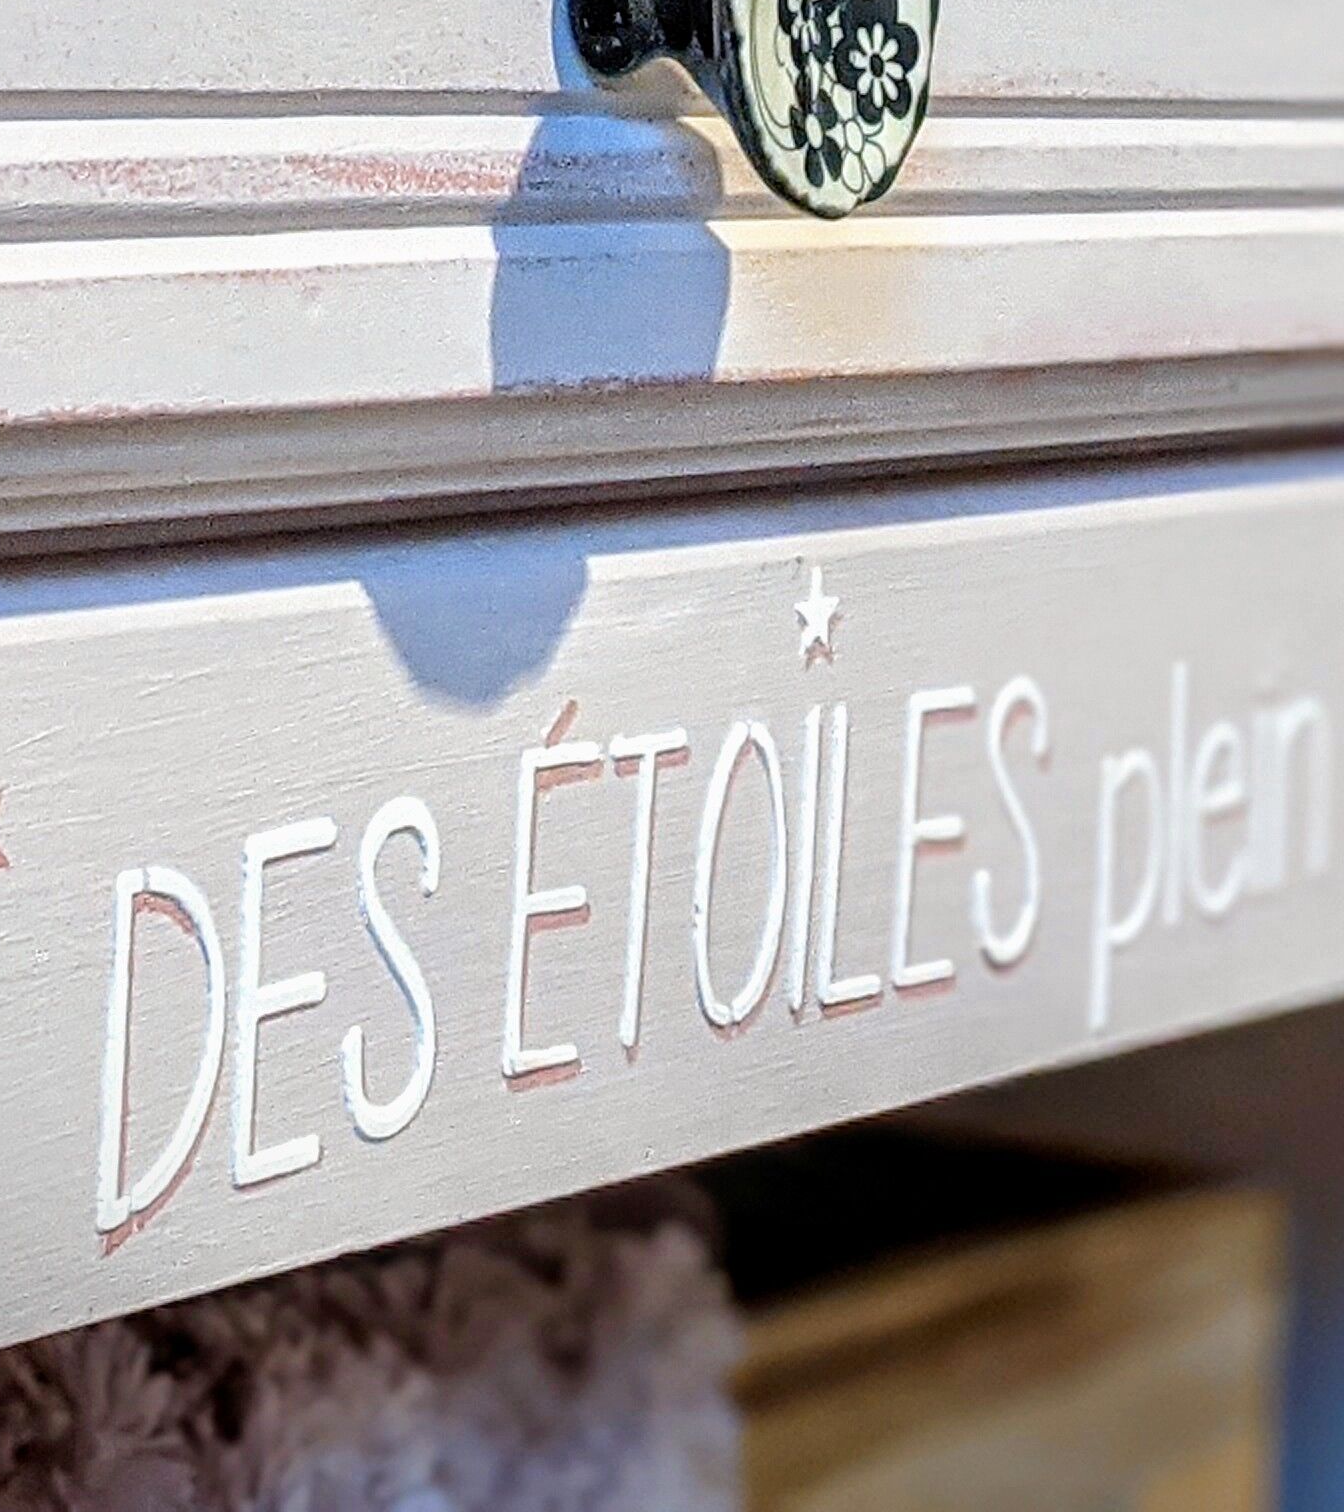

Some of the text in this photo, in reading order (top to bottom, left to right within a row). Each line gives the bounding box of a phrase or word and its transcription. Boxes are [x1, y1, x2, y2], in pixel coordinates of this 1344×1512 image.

[94, 794, 444, 1254] DES
[501, 673, 1054, 1088] ÉTOILES
[1089, 660, 1334, 1030] plein
